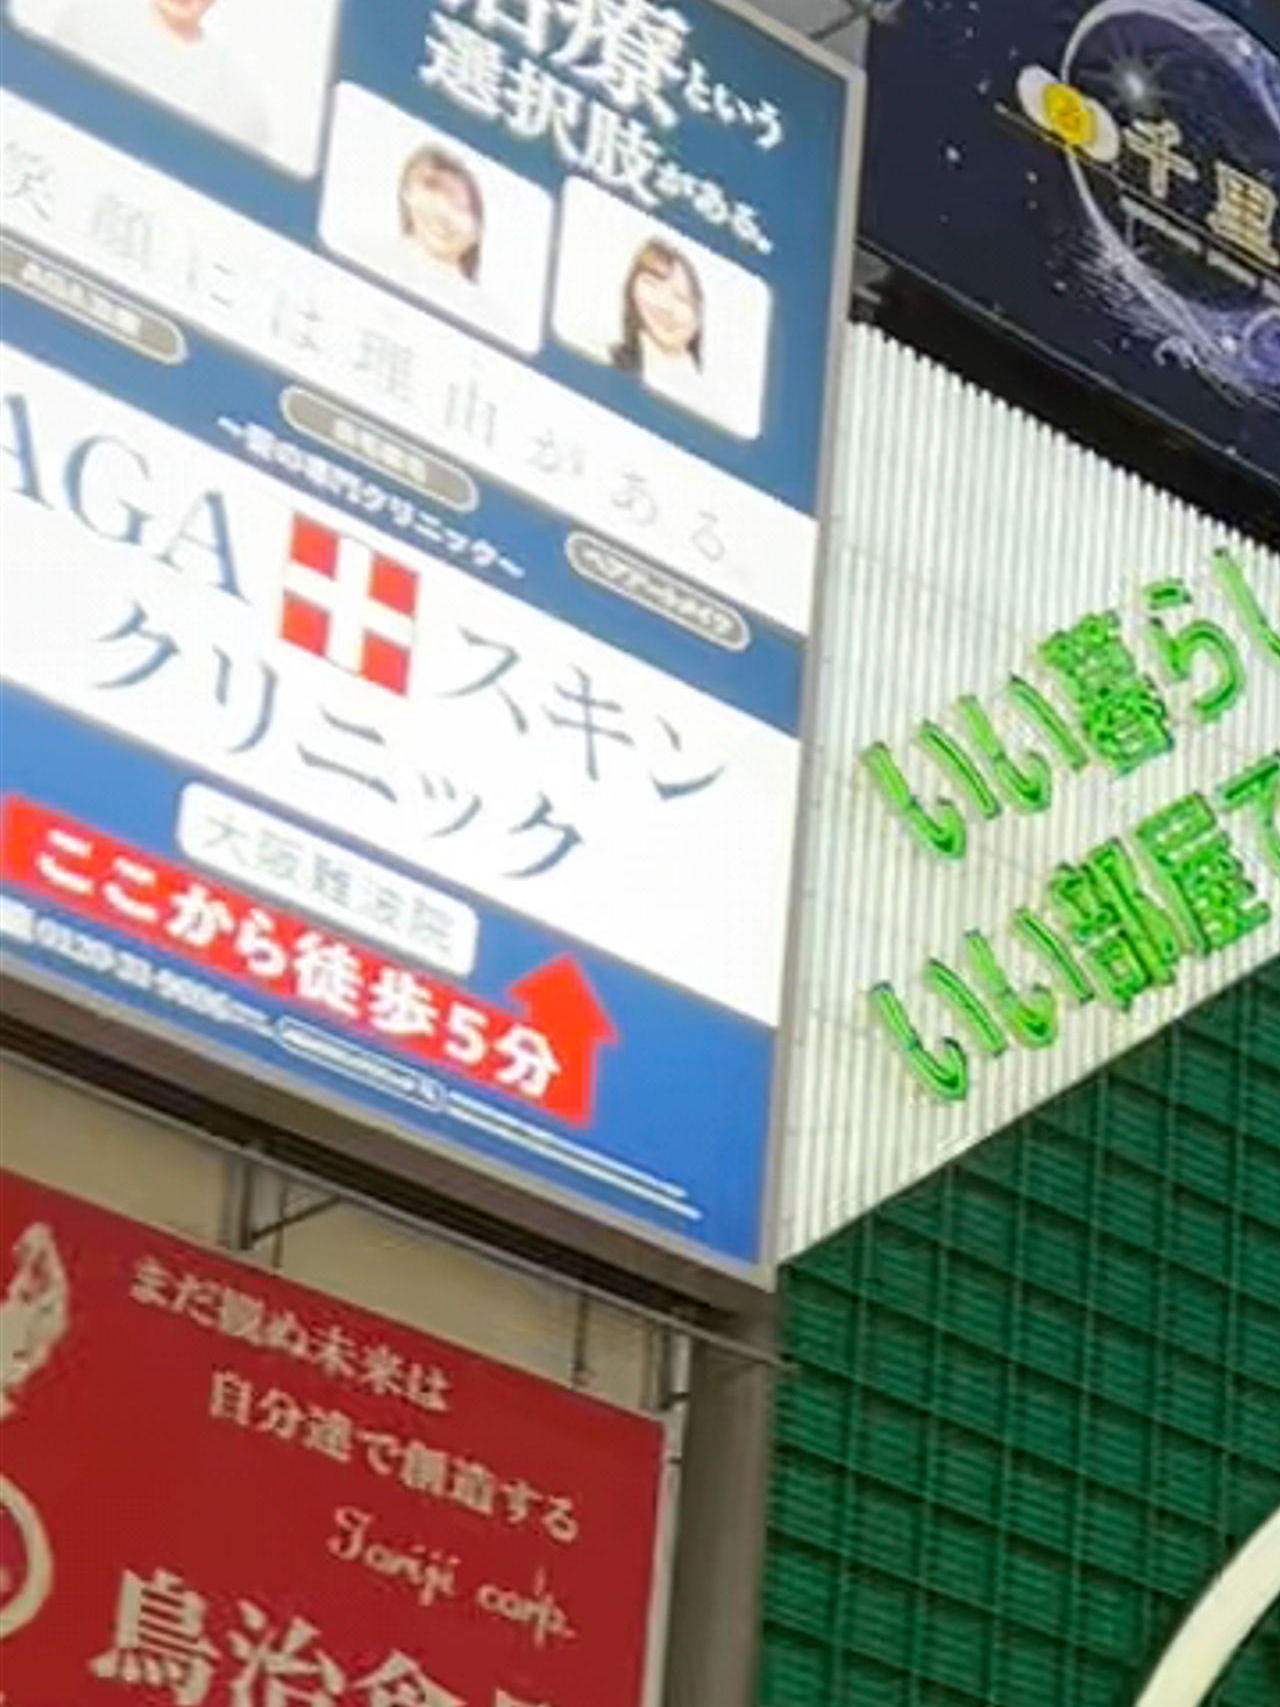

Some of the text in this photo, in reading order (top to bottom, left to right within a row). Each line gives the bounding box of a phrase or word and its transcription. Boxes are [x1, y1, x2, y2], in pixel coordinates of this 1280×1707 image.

[96, 599, 585, 880] クリニック
[443, 627, 724, 802] スキン
[36, 829, 561, 1101] ここから徒歩5分
